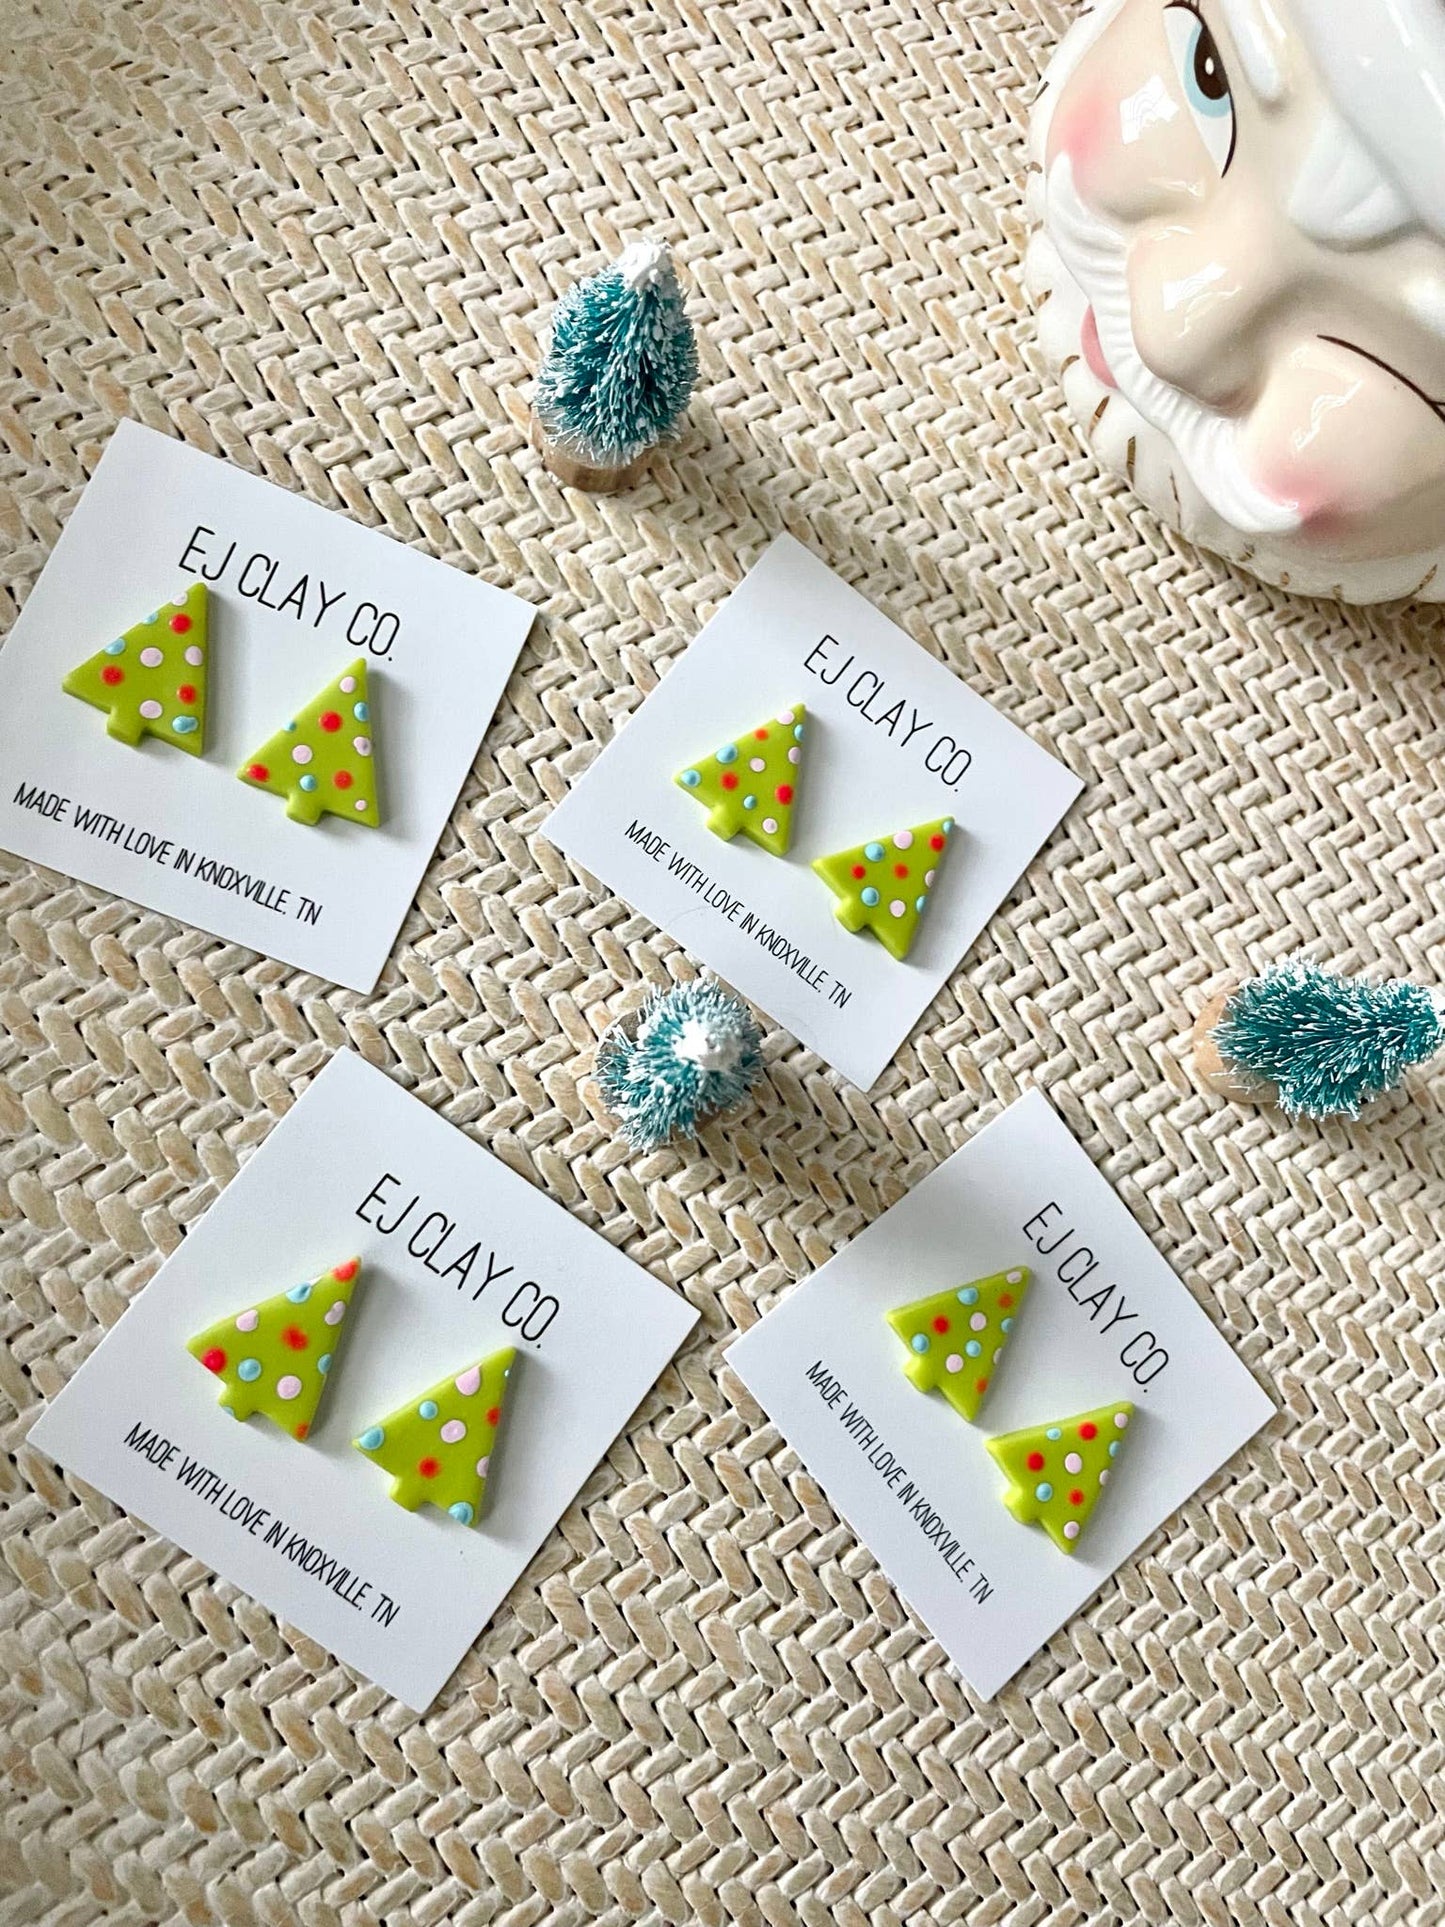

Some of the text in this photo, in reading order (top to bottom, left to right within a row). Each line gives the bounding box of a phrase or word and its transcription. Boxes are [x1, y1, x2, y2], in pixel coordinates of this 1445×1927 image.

[178, 526, 400, 661] EJ CLAY CO.
[804, 634, 971, 792] EJ CLAY CO.
[13, 782, 71, 822] MADE
[74, 805, 125, 844] WITH
[123, 828, 174, 865] LOVE
[173, 848, 196, 873] IN
[297, 897, 322, 925] TN
[625, 820, 671, 862] MADE
[668, 852, 709, 893] WITH
[704, 883, 744, 922] LOVE
[739, 912, 760, 934] IN
[828, 981, 852, 1008] TN
[356, 1173, 559, 1349] EJ CLAY CO.
[1022, 1202, 1169, 1394] EJ CLAY CO.
[124, 1422, 180, 1471] MADE
[176, 1456, 228, 1504] WITH
[219, 1489, 271, 1535] LOVE
[263, 1520, 289, 1548] IN
[371, 1594, 400, 1627] TN
[805, 1361, 848, 1410] MADE
[840, 1402, 878, 1451] WITH
[868, 1443, 907, 1489] LOVE
[897, 1481, 919, 1505] IN
[969, 1573, 994, 1604] TN
